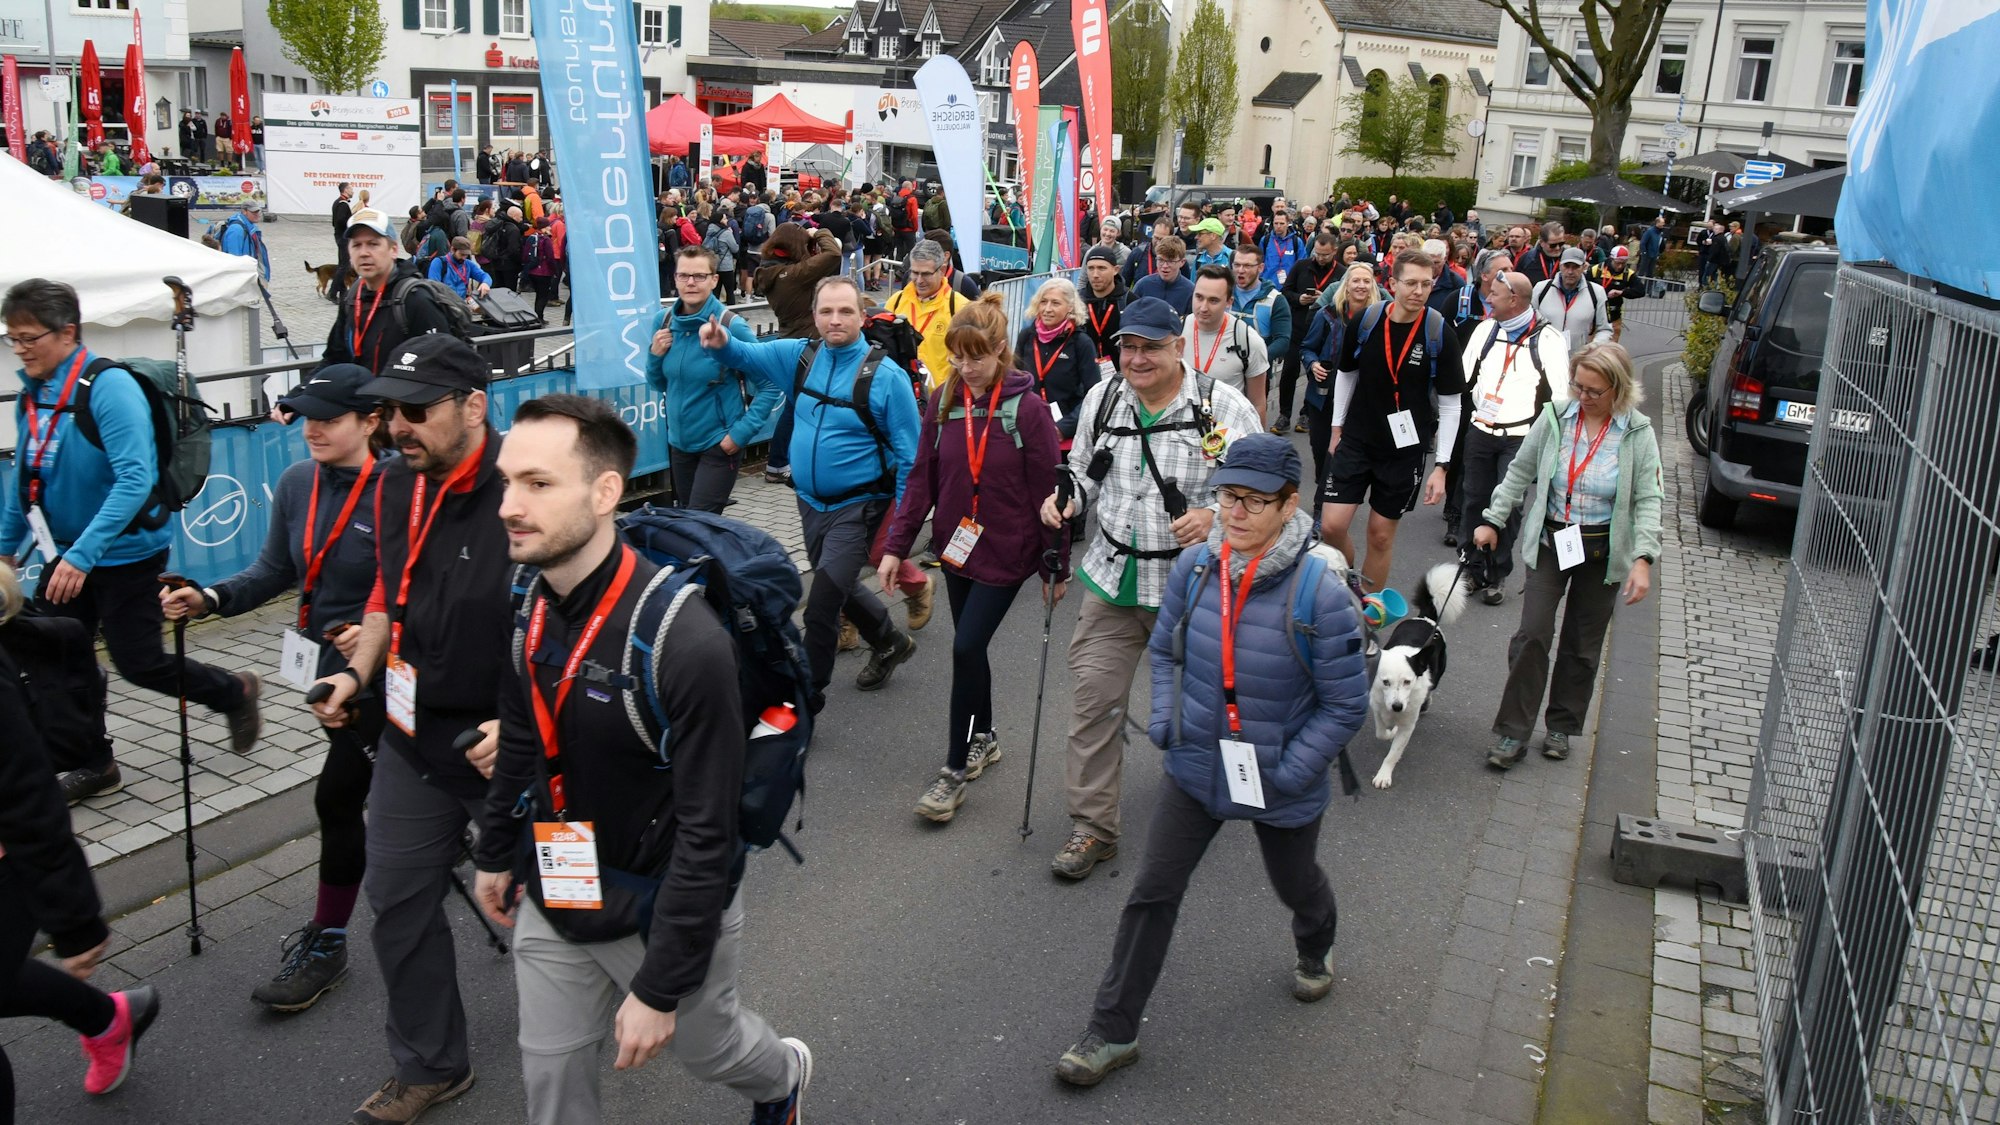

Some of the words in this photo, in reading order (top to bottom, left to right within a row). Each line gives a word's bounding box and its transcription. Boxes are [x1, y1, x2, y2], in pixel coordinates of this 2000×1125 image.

[0, 19, 24, 40] FE
[316, 121, 349, 129] Wanderevent
[358, 123, 385, 131] Bergischen
[304, 171, 317, 179] DER
[1787, 404, 1808, 419] GM
